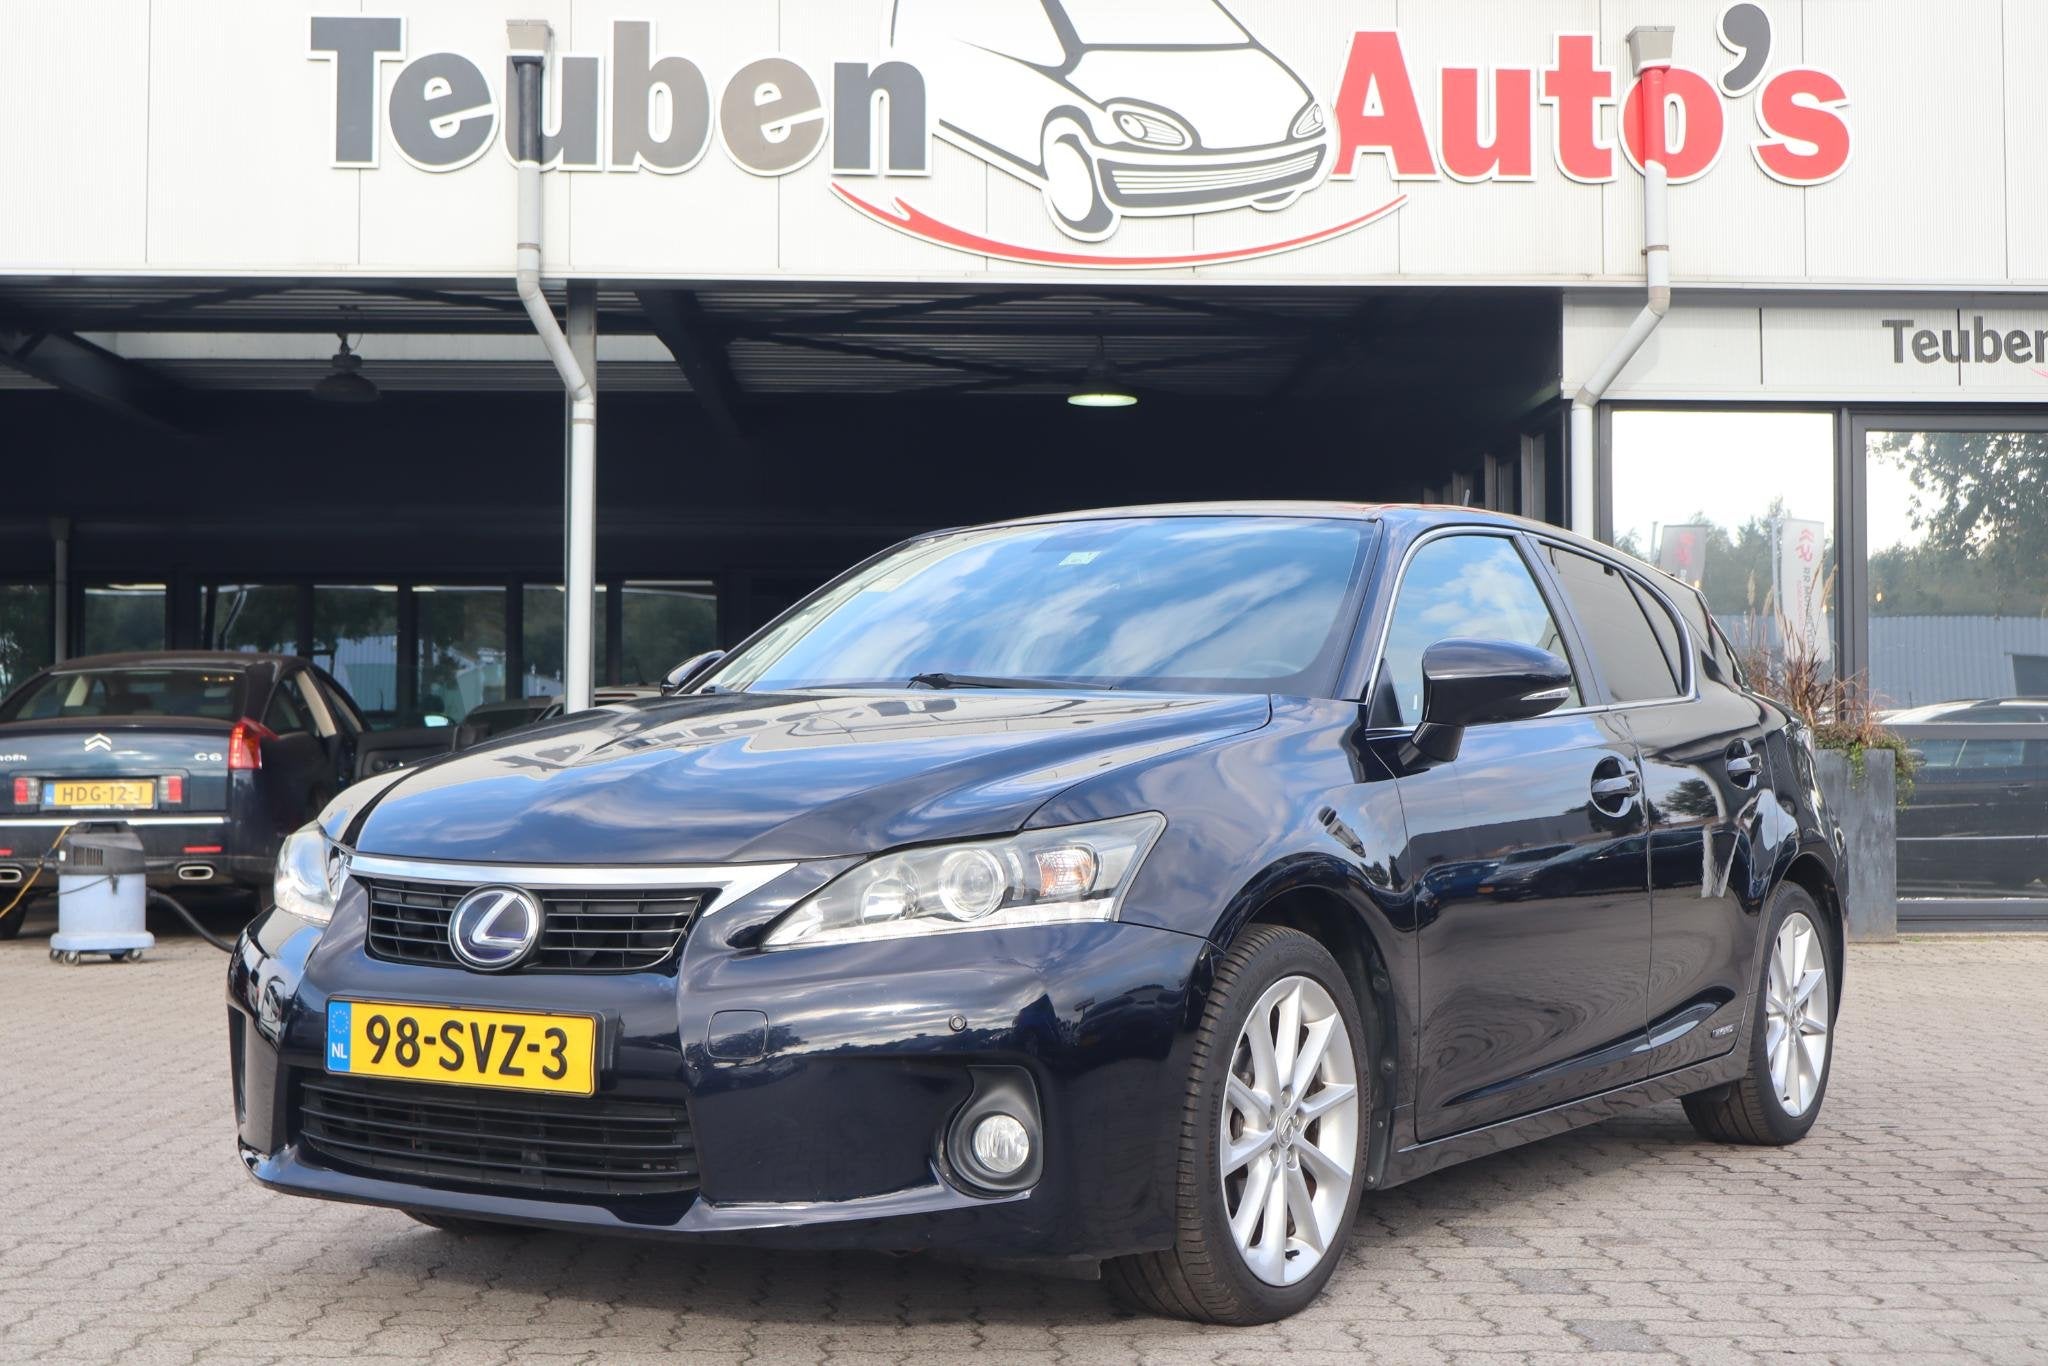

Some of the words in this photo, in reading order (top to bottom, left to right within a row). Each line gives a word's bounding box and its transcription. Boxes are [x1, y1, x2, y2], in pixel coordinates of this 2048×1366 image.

[307, 15, 930, 177] Teuben
[1330, 2, 1852, 186] Auto's
[63, 785, 143, 801] HDG-12-J
[331, 1043, 348, 1059] NL
[366, 1014, 568, 1080] 98-SVZ-3
